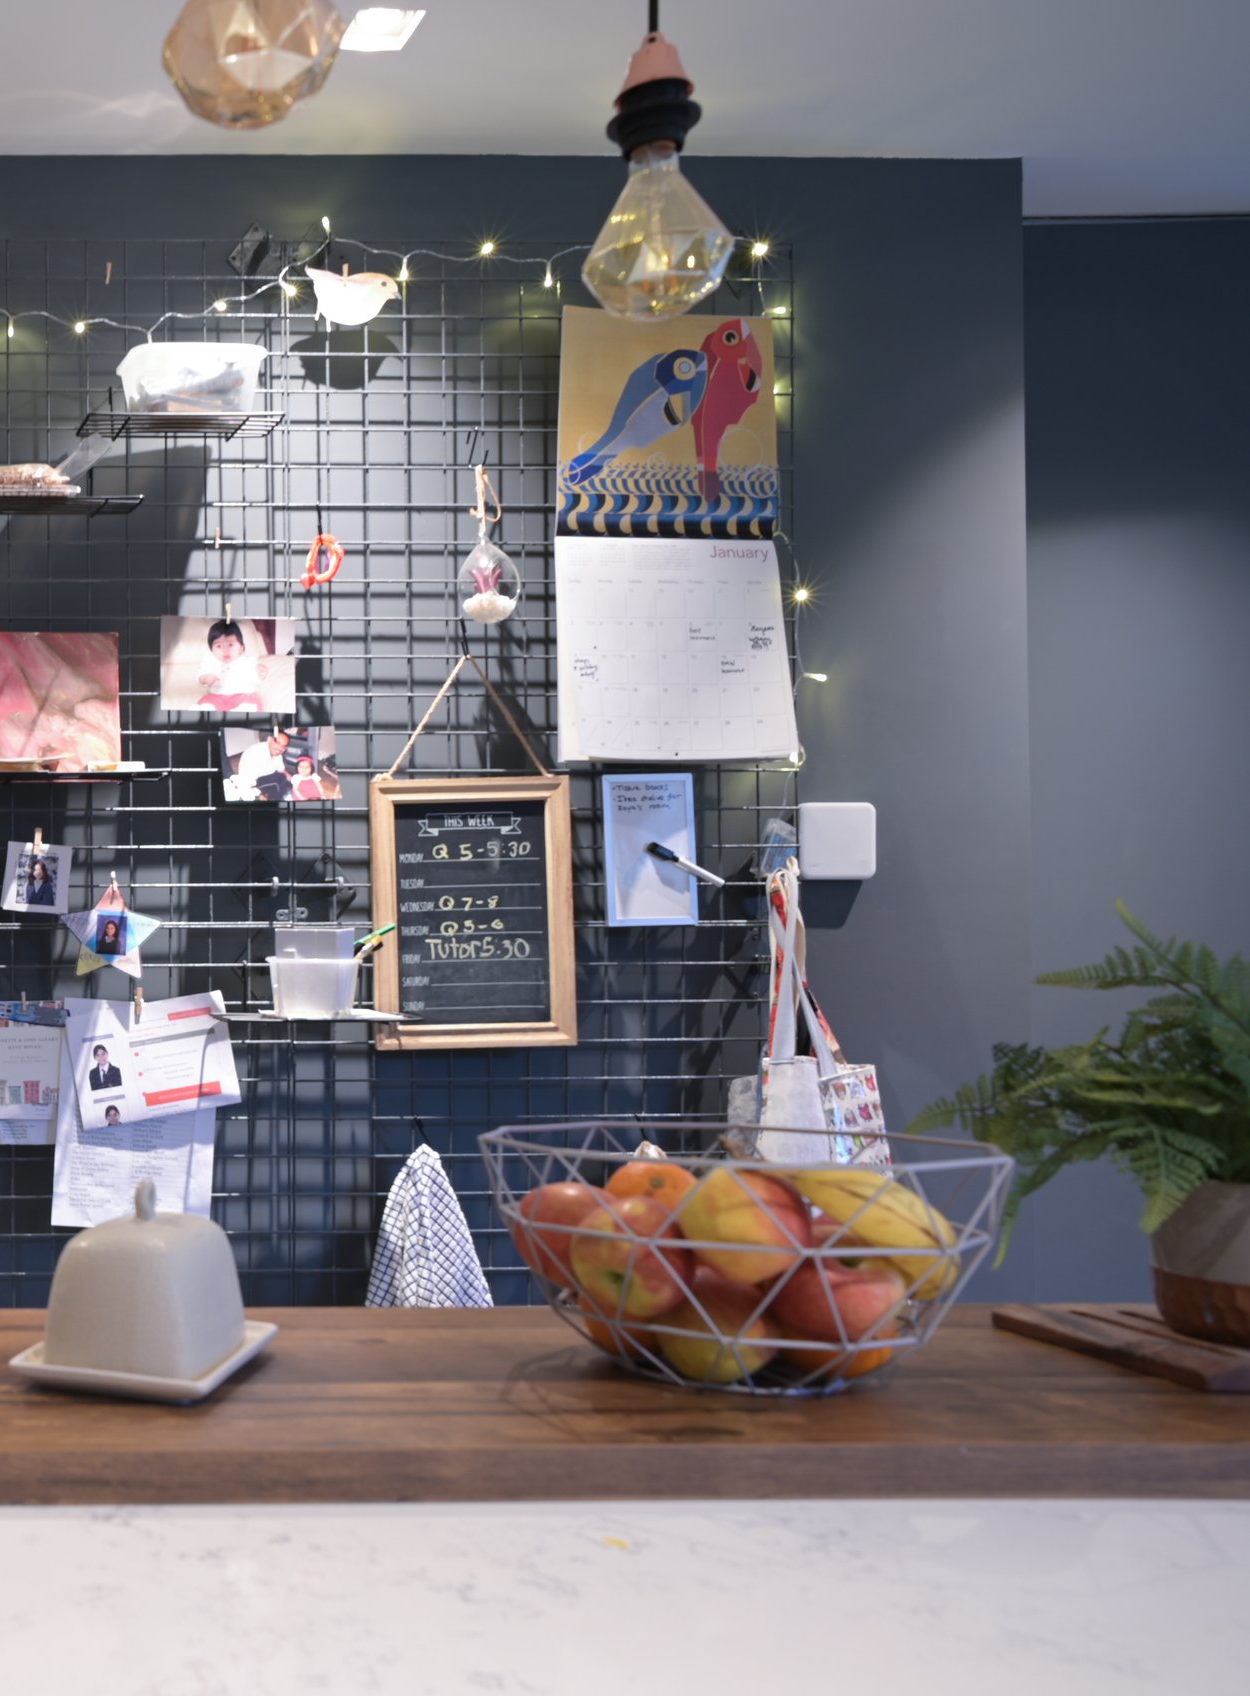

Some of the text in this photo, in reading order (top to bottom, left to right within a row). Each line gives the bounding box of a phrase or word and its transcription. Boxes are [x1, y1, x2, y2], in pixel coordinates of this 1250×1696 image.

[709, 545, 769, 562] January
[443, 814, 495, 828] THIS WEEK
[431, 842, 449, 859] Q
[399, 853, 424, 864] MONDAY
[400, 879, 424, 889] TUESDAY
[400, 901, 435, 912] WEDNESDAY
[438, 895, 455, 911] Q
[401, 926, 430, 936] THURSDAY
[440, 921, 459, 936] Q
[402, 954, 421, 964] FRIDAY
[402, 977, 430, 987] SATURDAY
[402, 1001, 425, 1012] SUNDAY
